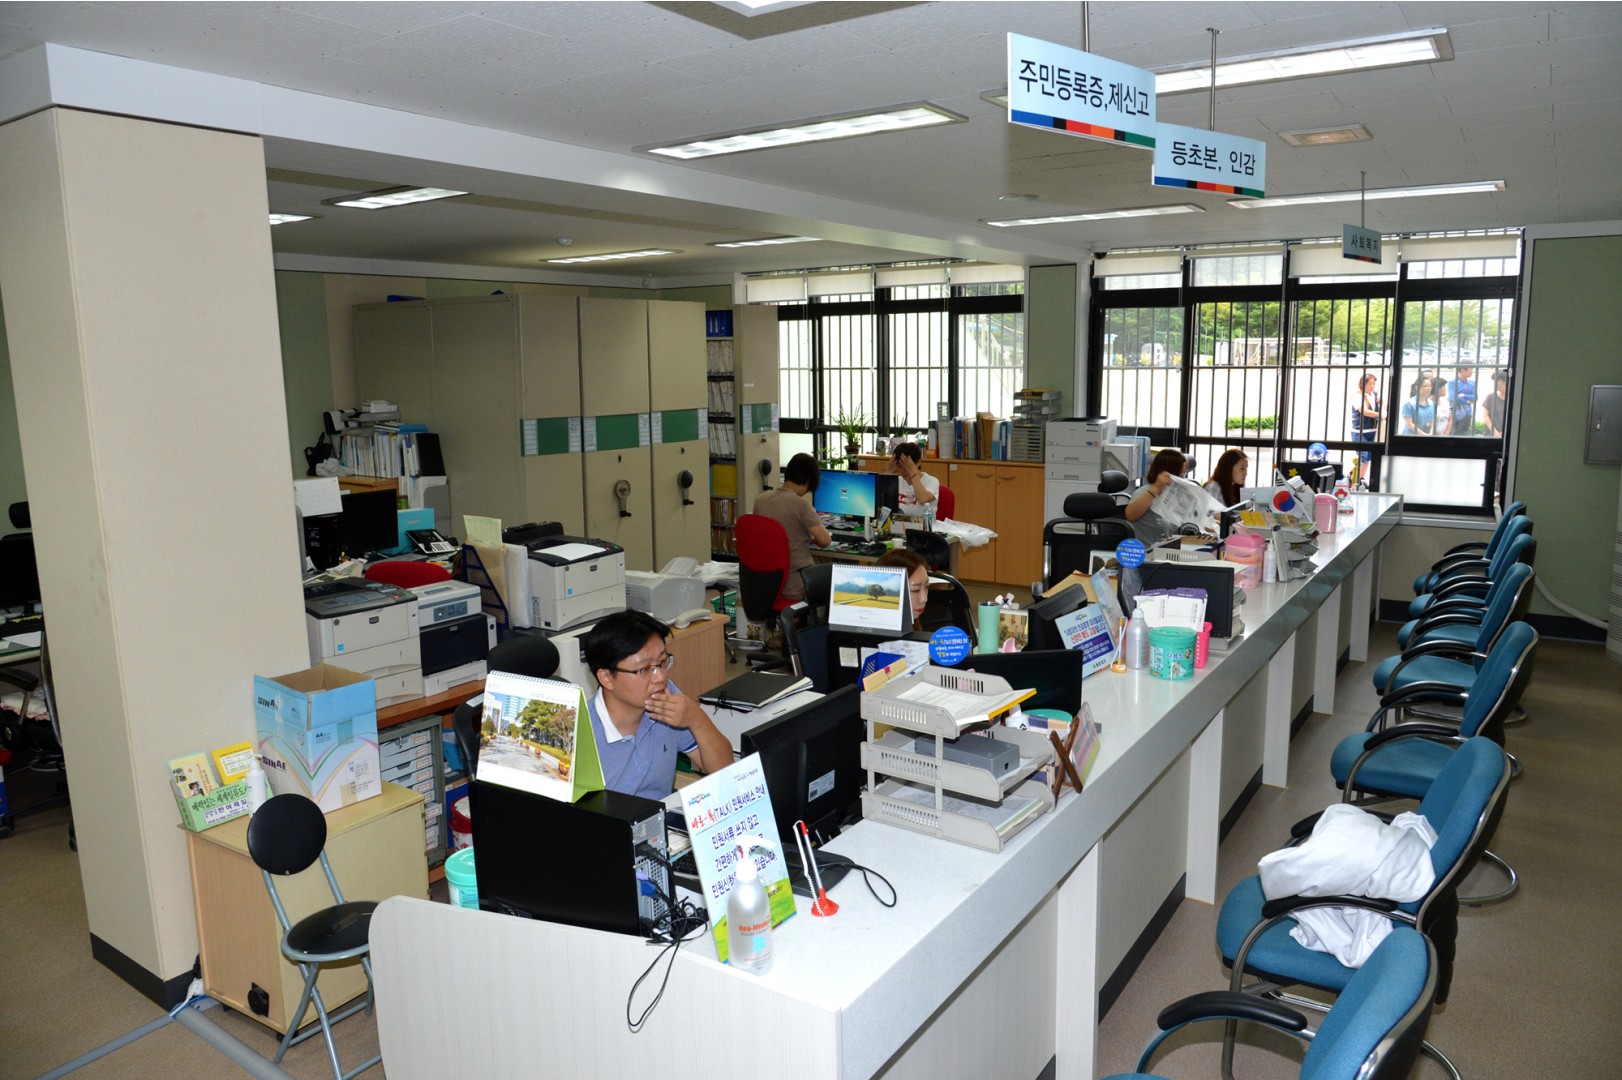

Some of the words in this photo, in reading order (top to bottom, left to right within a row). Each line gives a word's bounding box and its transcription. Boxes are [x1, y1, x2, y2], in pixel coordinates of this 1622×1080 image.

[1019, 59, 1150, 117] 주민등록증,제신고
[1171, 141, 1222, 172] 등초본,
[1229, 150, 1256, 176] 인감
[1351, 234, 1379, 253] 사회복지
[755, 783, 766, 799] 안내
[711, 826, 735, 850] 민원서류
[735, 819, 748, 836] 쓰지
[747, 814, 760, 830] 않고
[714, 846, 739, 873] 간편하게
